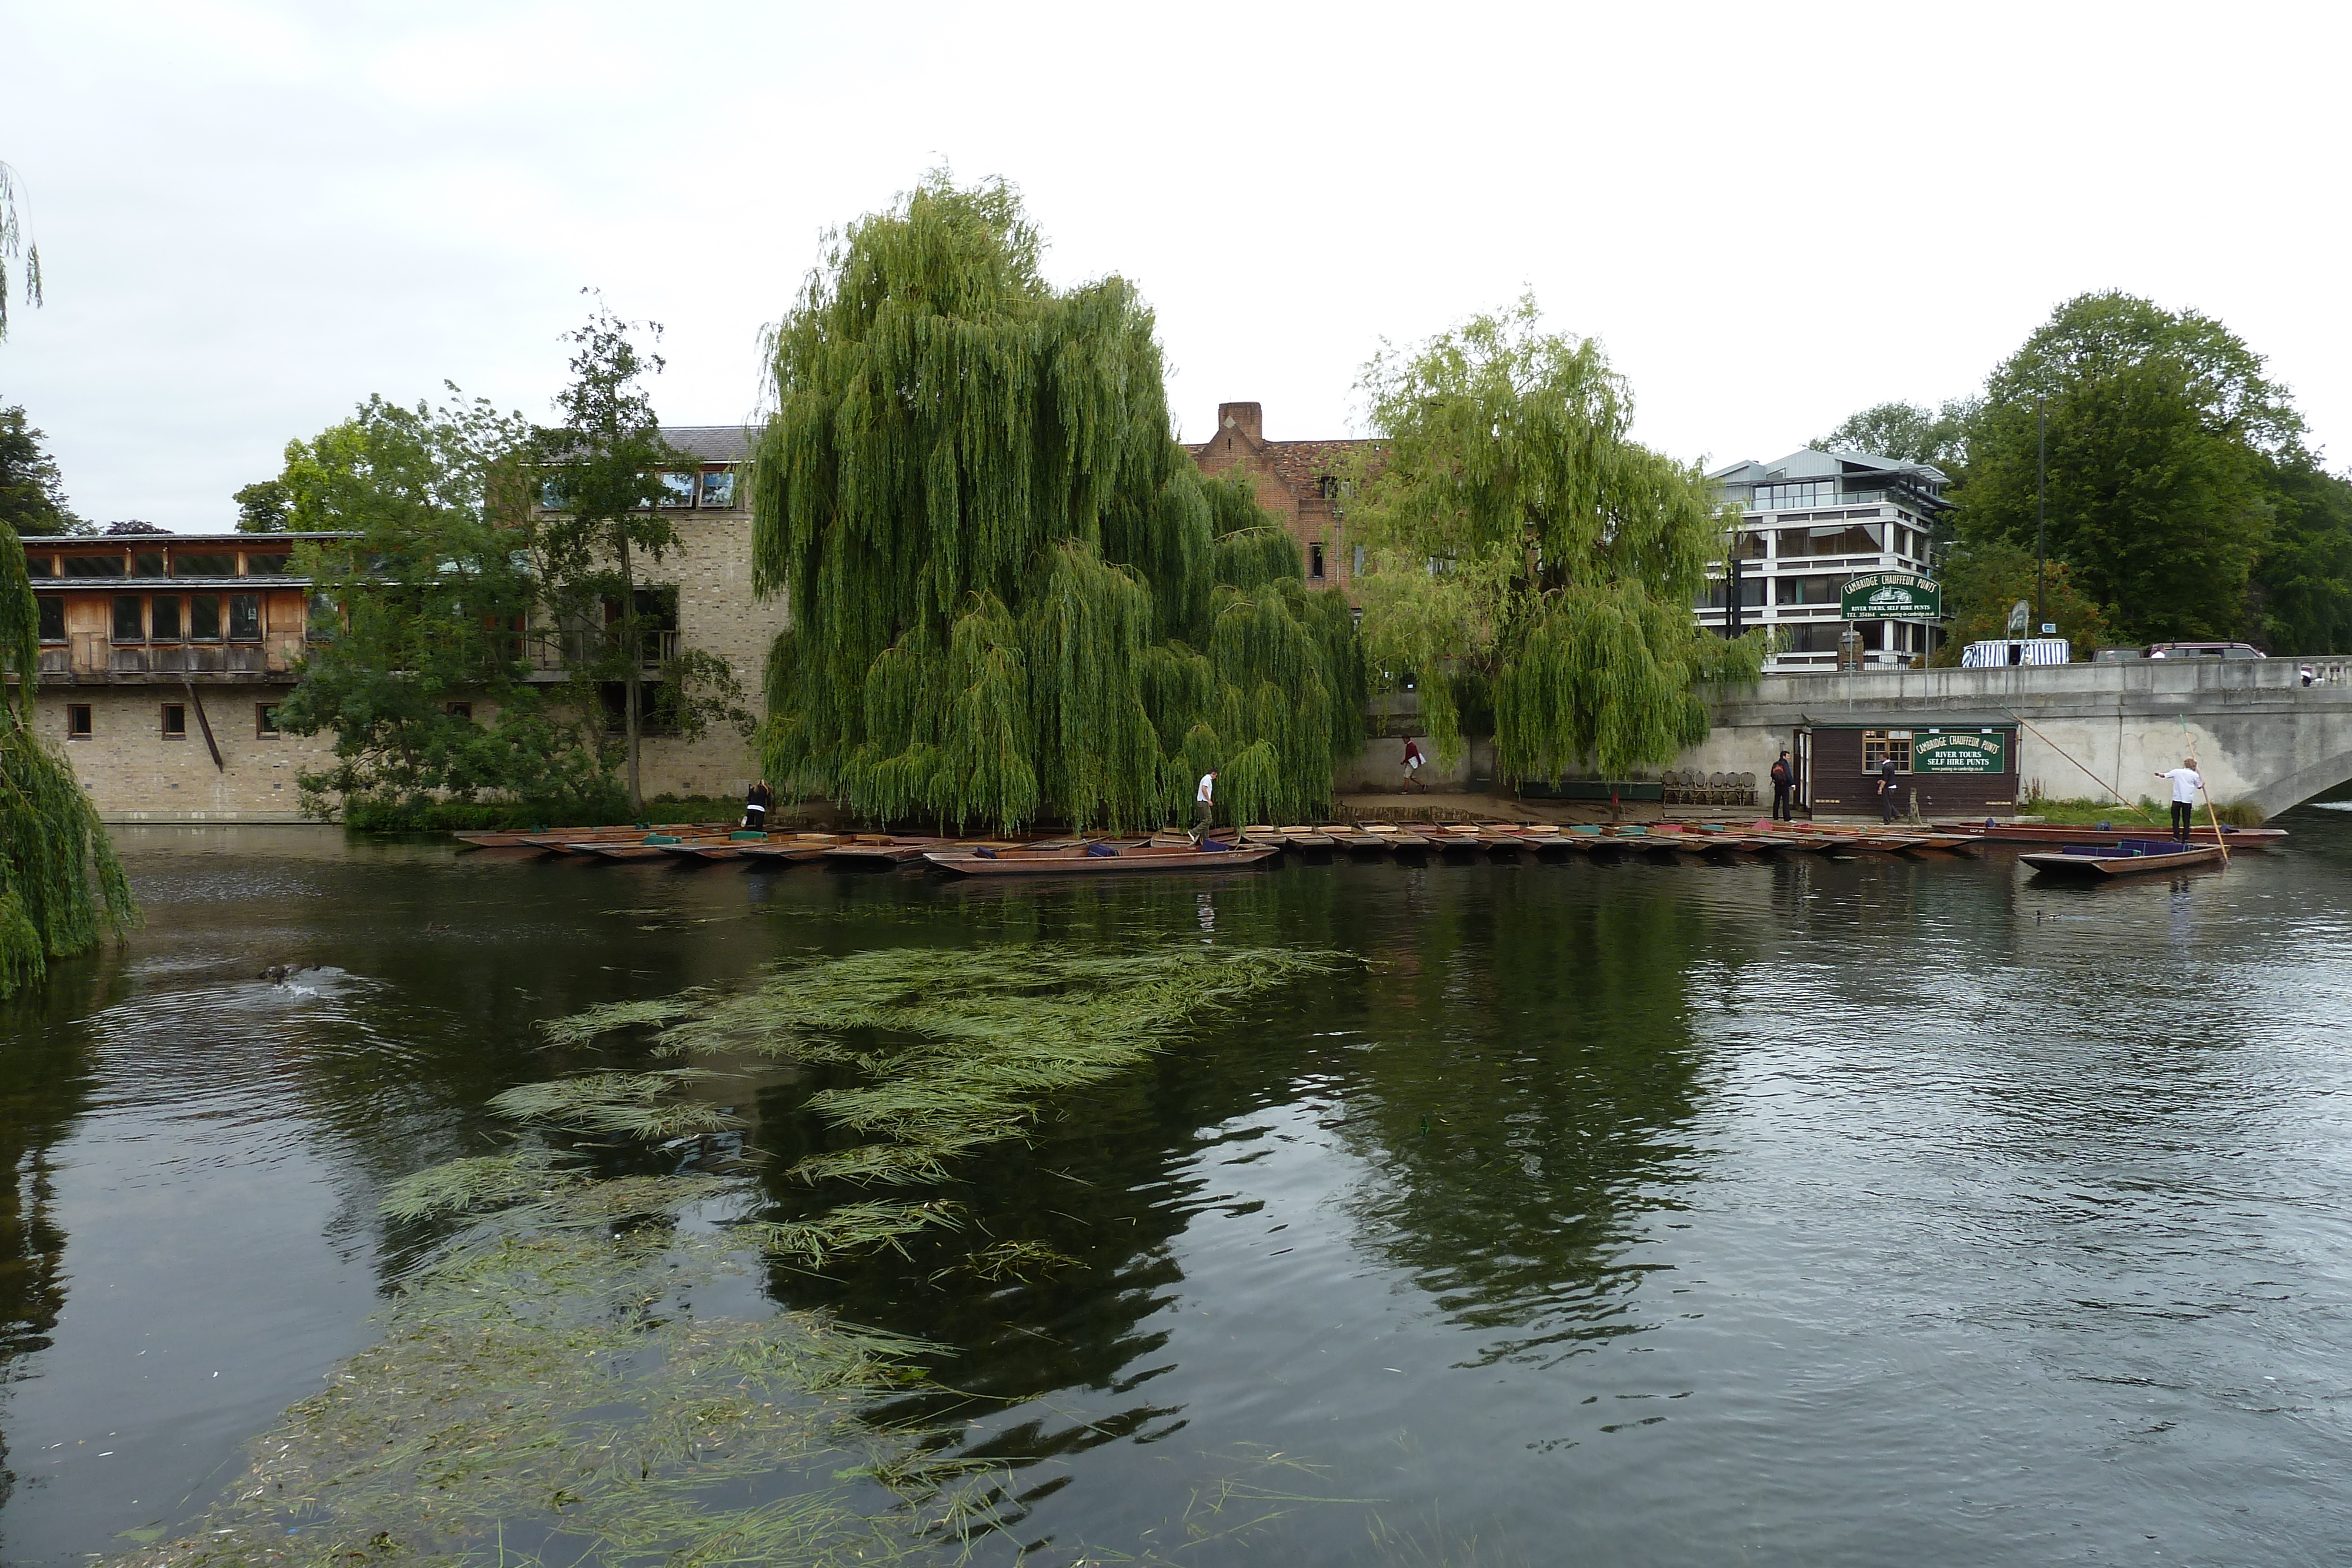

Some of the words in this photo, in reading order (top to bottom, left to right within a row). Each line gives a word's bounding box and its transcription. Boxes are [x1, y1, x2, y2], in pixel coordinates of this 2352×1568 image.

[1845, 576, 1879, 594] CAMBRIDGE
[1882, 575, 1915, 586] CHAUFFEUR
[1916, 578, 1937, 593] PUNTS
[1916, 737, 1947, 754] CAMBRIDGE
[1949, 735, 1980, 748] CHAUFFEUR
[1981, 740, 2000, 754] PUNTS
